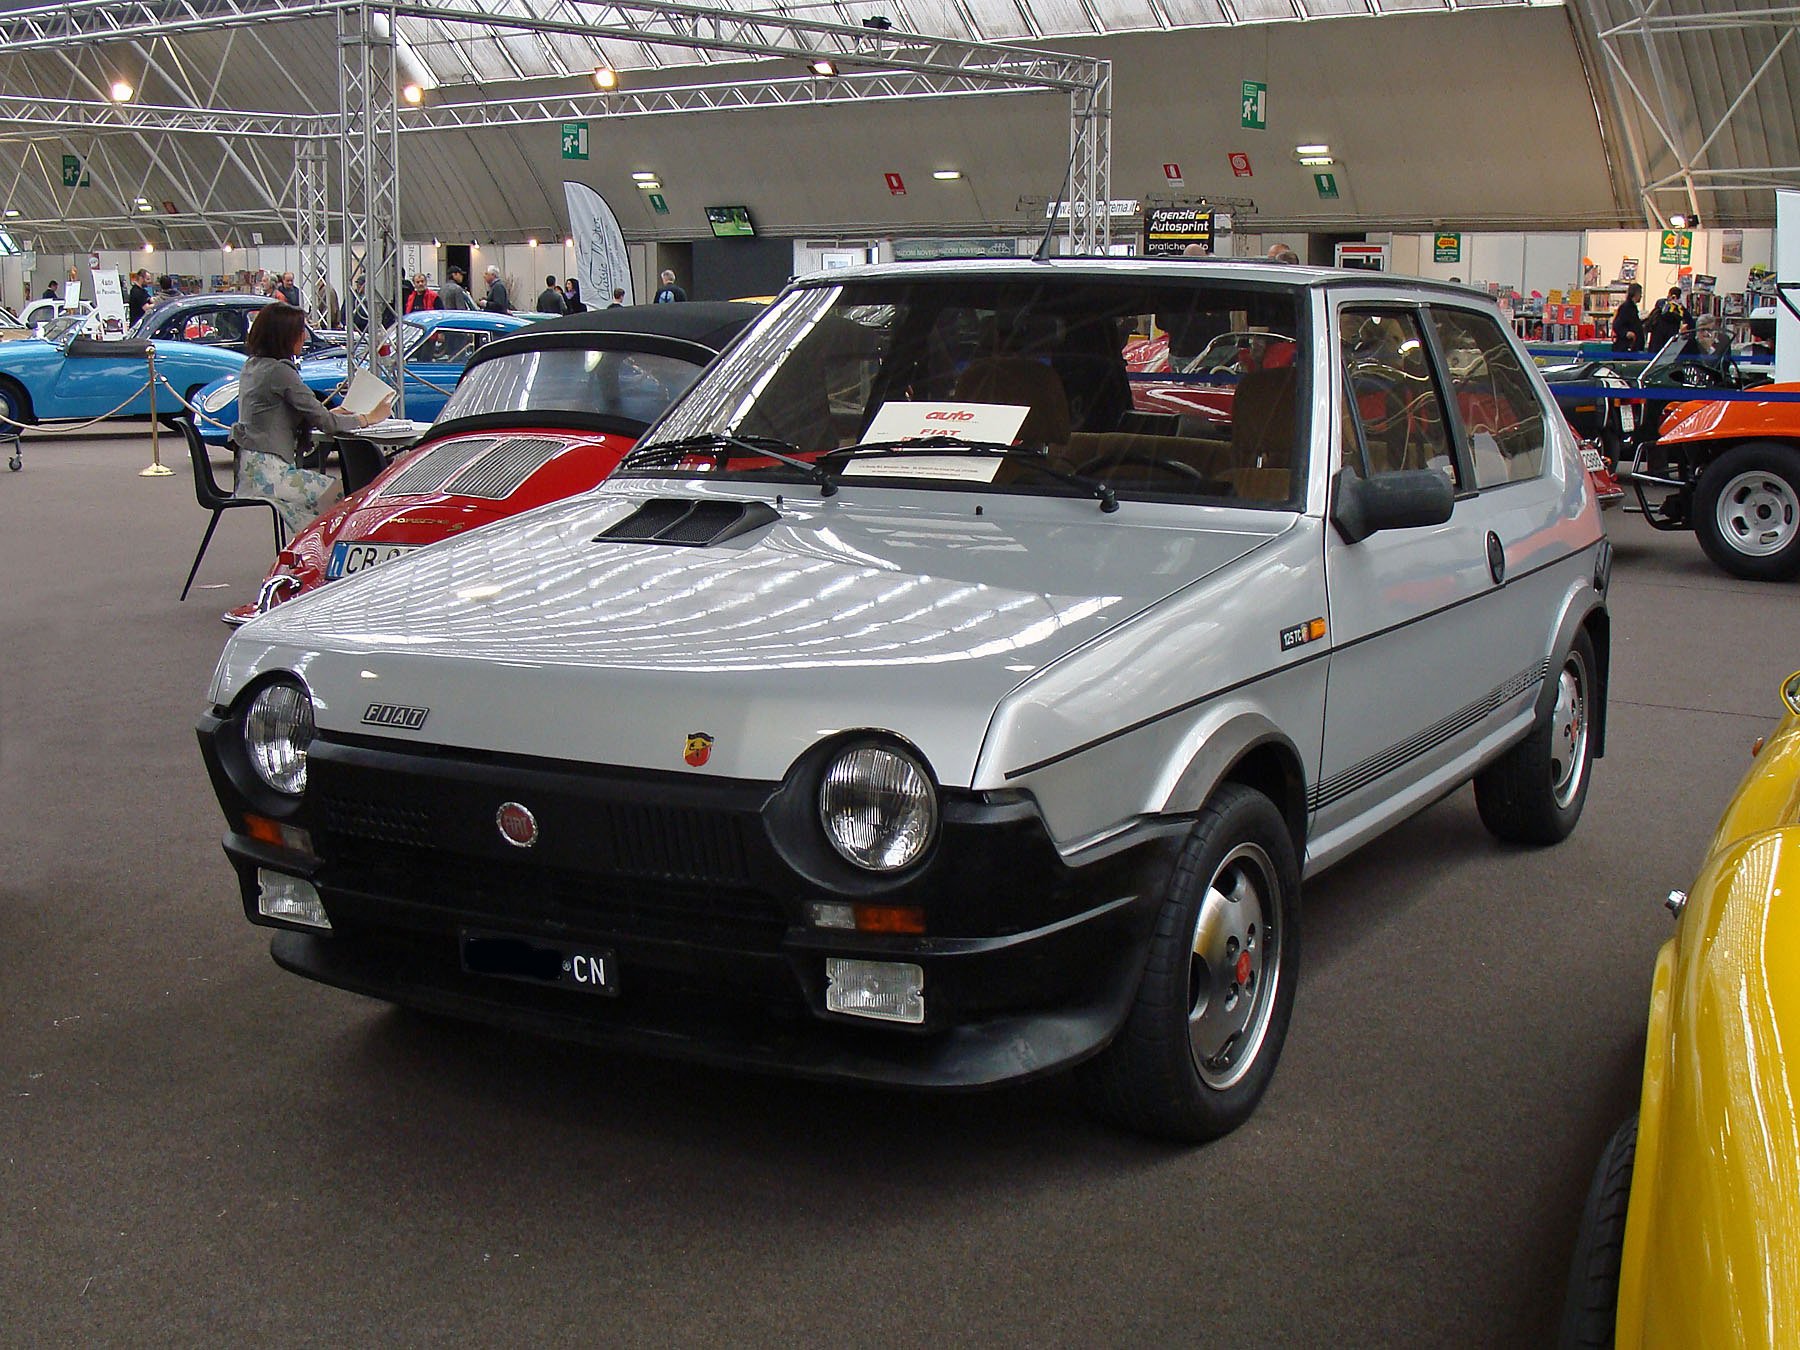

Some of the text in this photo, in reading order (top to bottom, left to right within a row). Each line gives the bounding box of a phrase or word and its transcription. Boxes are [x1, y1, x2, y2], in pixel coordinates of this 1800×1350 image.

[1152, 210, 1195, 221] Agenzia
[1150, 221, 1209, 233] Autosprint
[1149, 243, 1186, 251] pratiche
[926, 411, 975, 421] auto
[1284, 632, 1294, 646] 125
[364, 705, 424, 726] FIAT
[573, 955, 605, 985] CN
